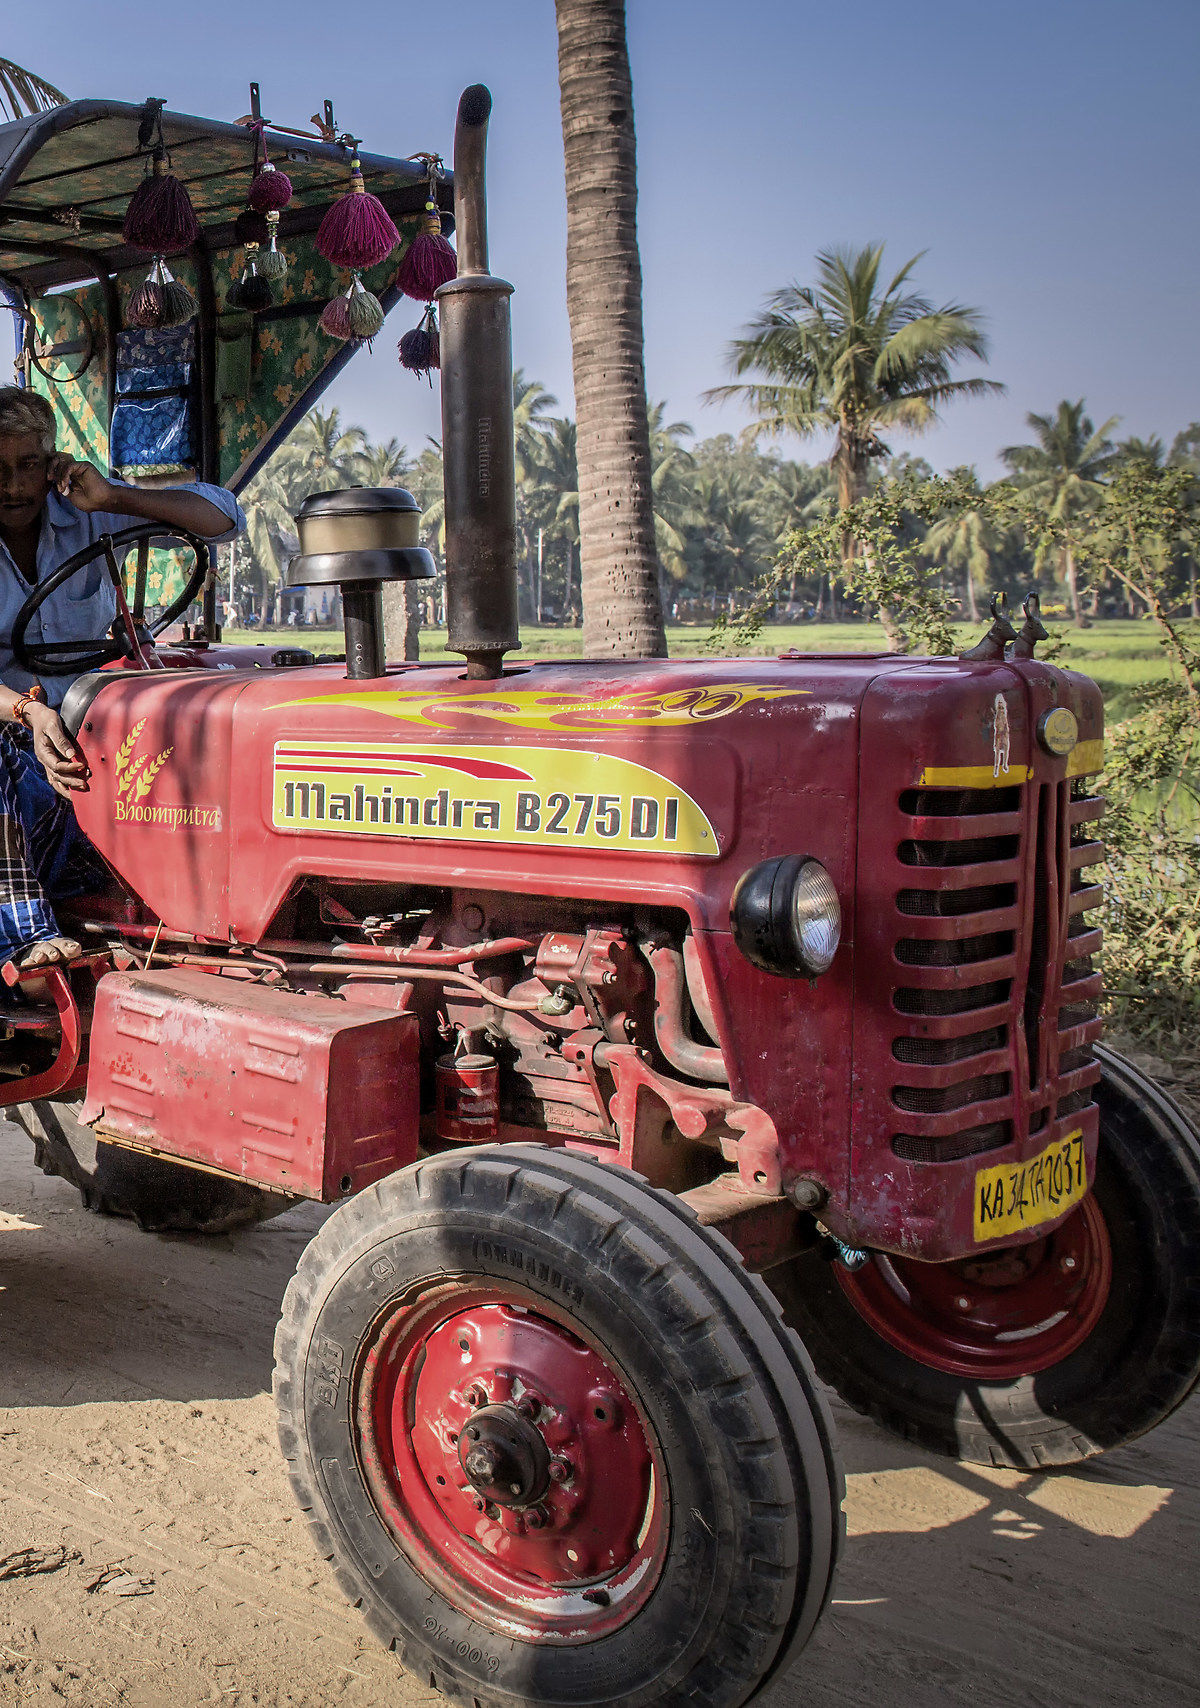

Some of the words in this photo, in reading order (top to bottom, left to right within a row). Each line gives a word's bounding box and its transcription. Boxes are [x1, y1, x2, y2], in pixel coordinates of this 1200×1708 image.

[115, 799, 218, 832] Bhoomiputra
[284, 781, 500, 830] Mahindra
[515, 791, 621, 839] B275
[629, 796, 679, 841] DI
[311, 1334, 344, 1409] BKT
